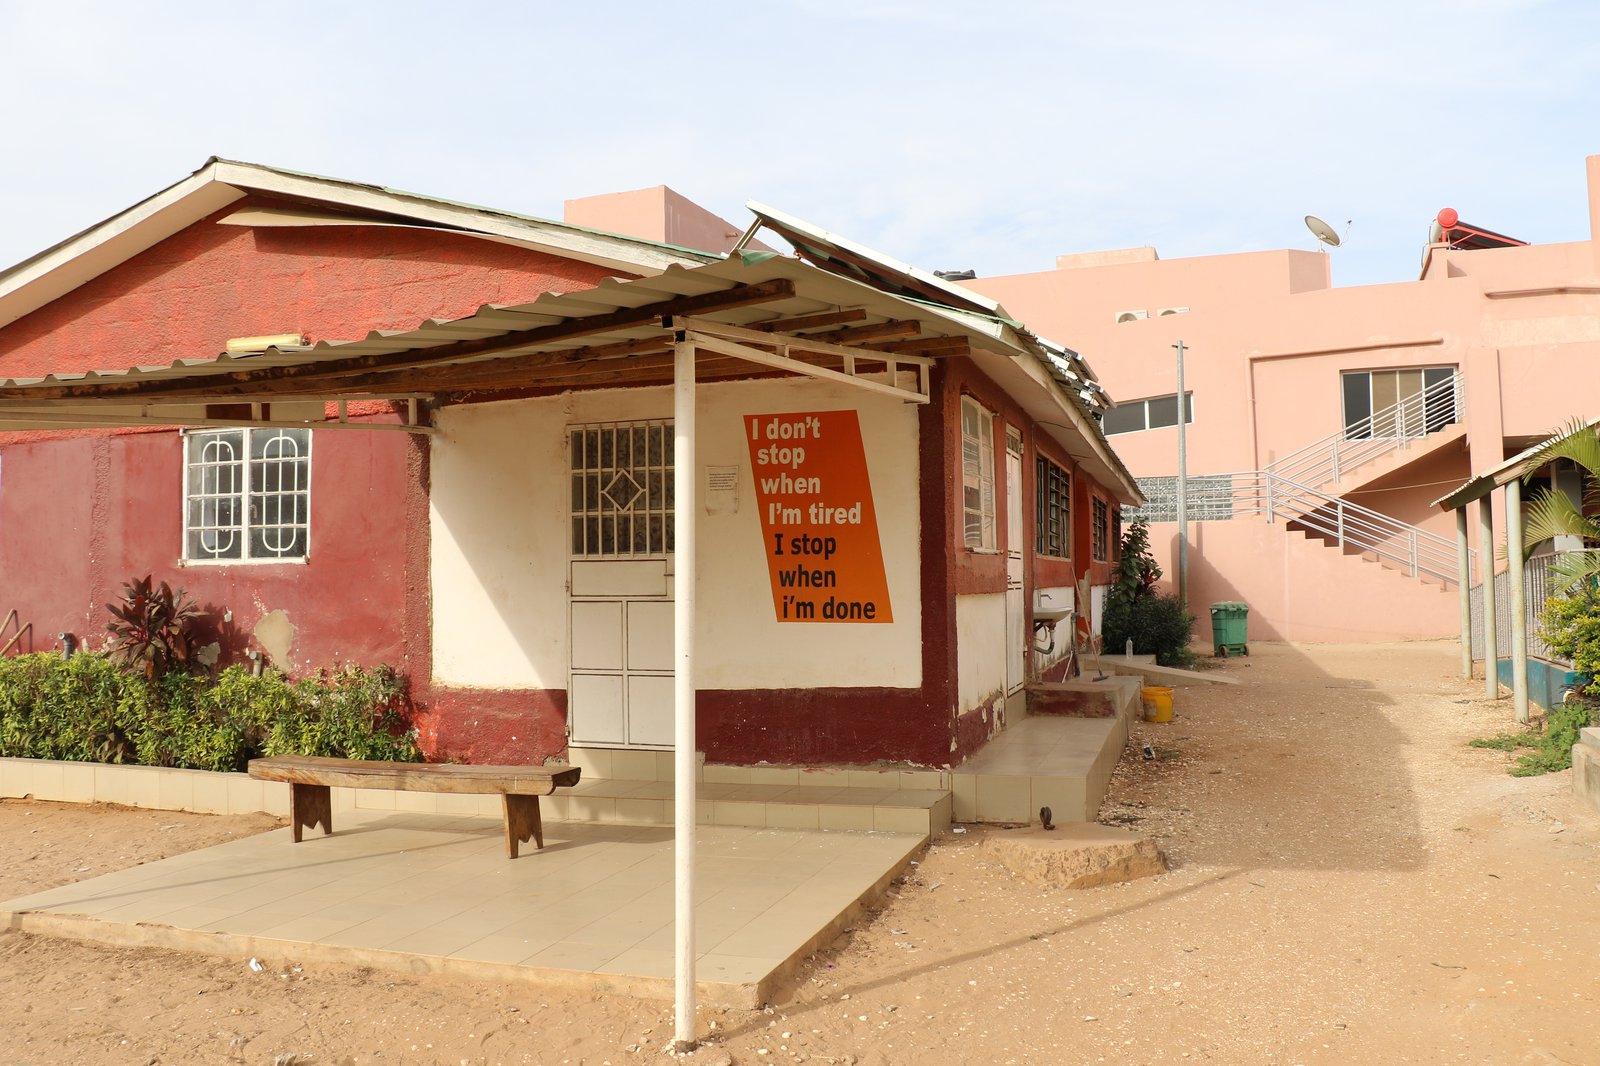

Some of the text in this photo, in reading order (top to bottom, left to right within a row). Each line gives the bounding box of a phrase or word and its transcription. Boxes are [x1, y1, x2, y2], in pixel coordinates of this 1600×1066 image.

[752, 416, 820, 440] I don't
[757, 443, 805, 469] stop
[761, 472, 820, 494] when
[769, 502, 861, 525] I'm tired
[775, 533, 836, 560] I stop
[779, 564, 836, 587] when
[783, 595, 876, 619] i'm done
